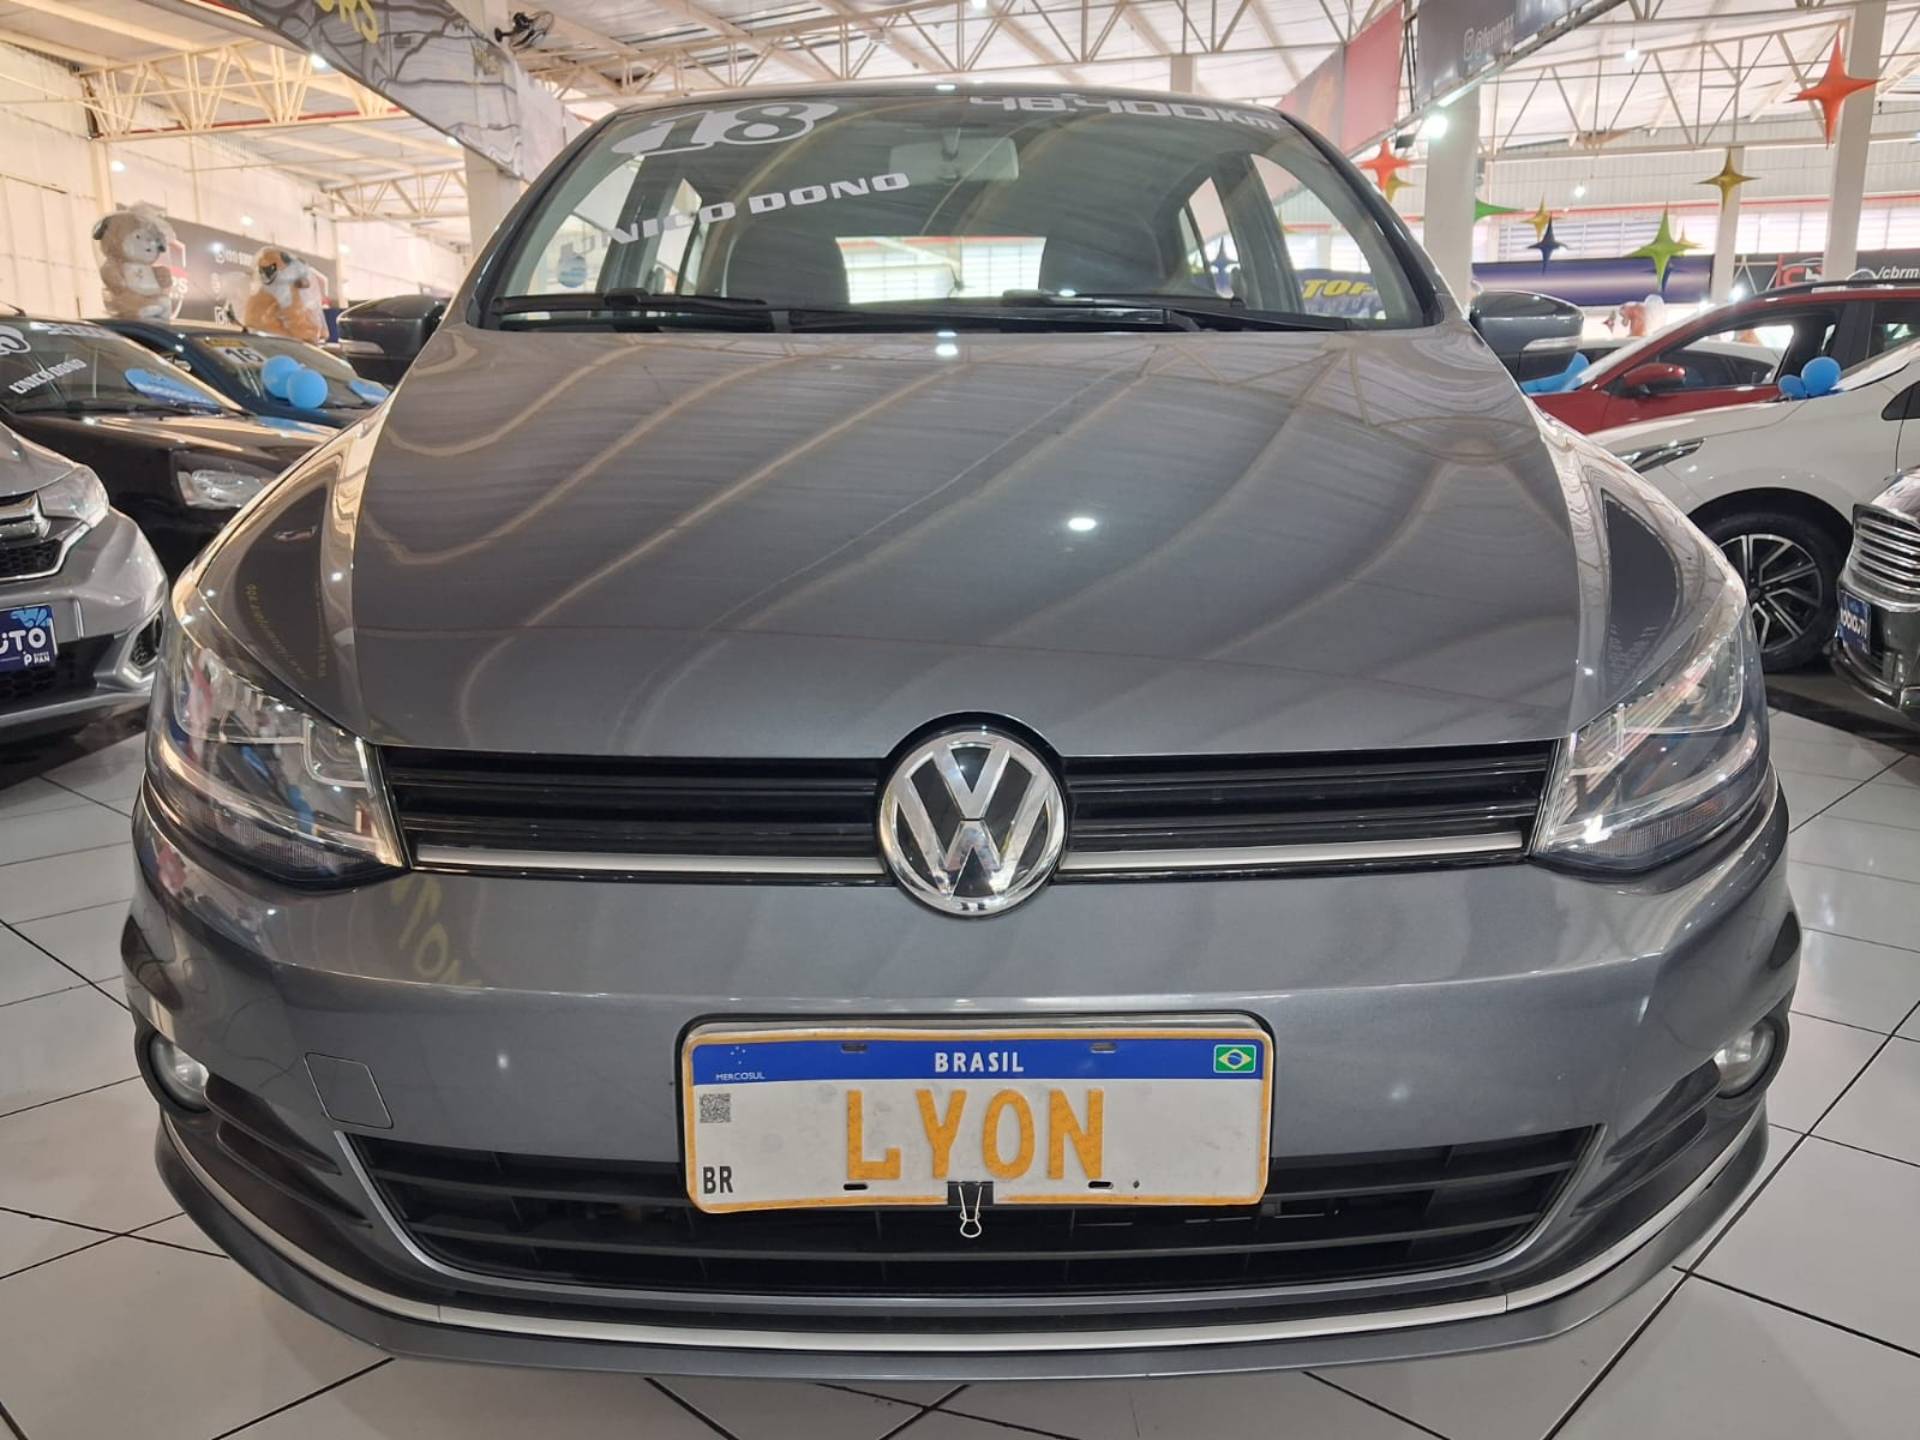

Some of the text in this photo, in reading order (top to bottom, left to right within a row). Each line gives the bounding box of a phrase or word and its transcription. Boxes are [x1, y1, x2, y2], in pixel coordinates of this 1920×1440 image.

[612, 102, 838, 157] 18
[748, 172, 911, 214] DONO
[715, 1071, 766, 1081] MERCOSUL
[934, 1051, 1024, 1073] BRASIL
[846, 1088, 1105, 1180] LYON
[702, 1165, 734, 1195] BR
